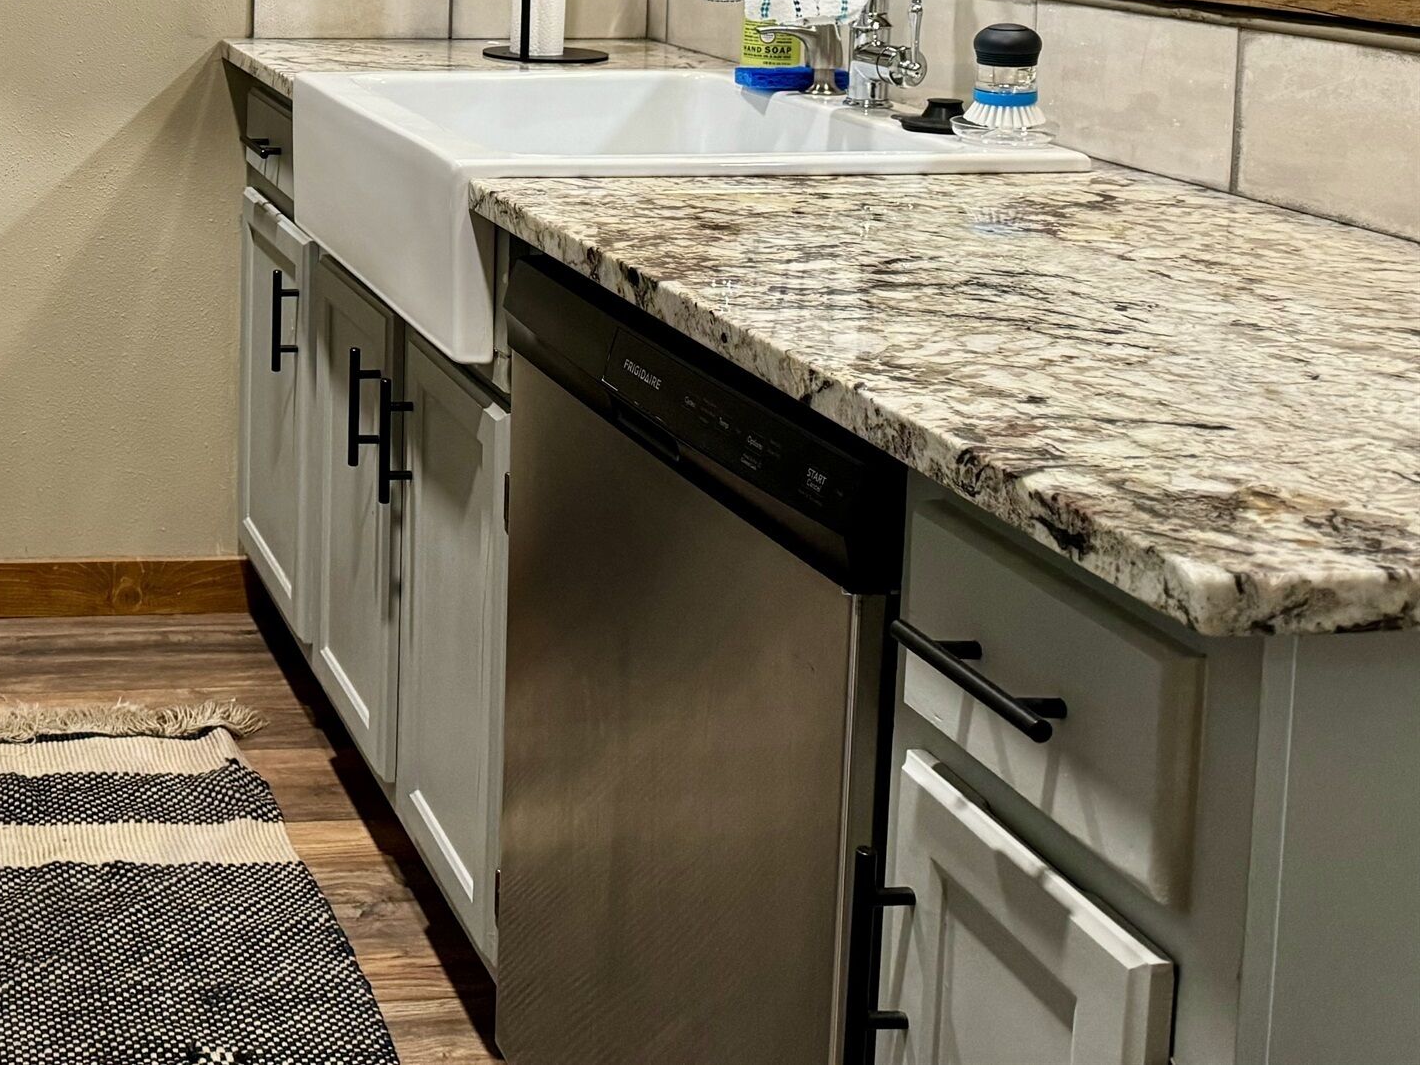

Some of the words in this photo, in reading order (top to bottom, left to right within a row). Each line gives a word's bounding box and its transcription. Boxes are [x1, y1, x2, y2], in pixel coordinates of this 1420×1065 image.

[764, 45, 792, 54] SOAP
[623, 358, 662, 391] FRIGIDAIRE
[806, 467, 827, 485] START
